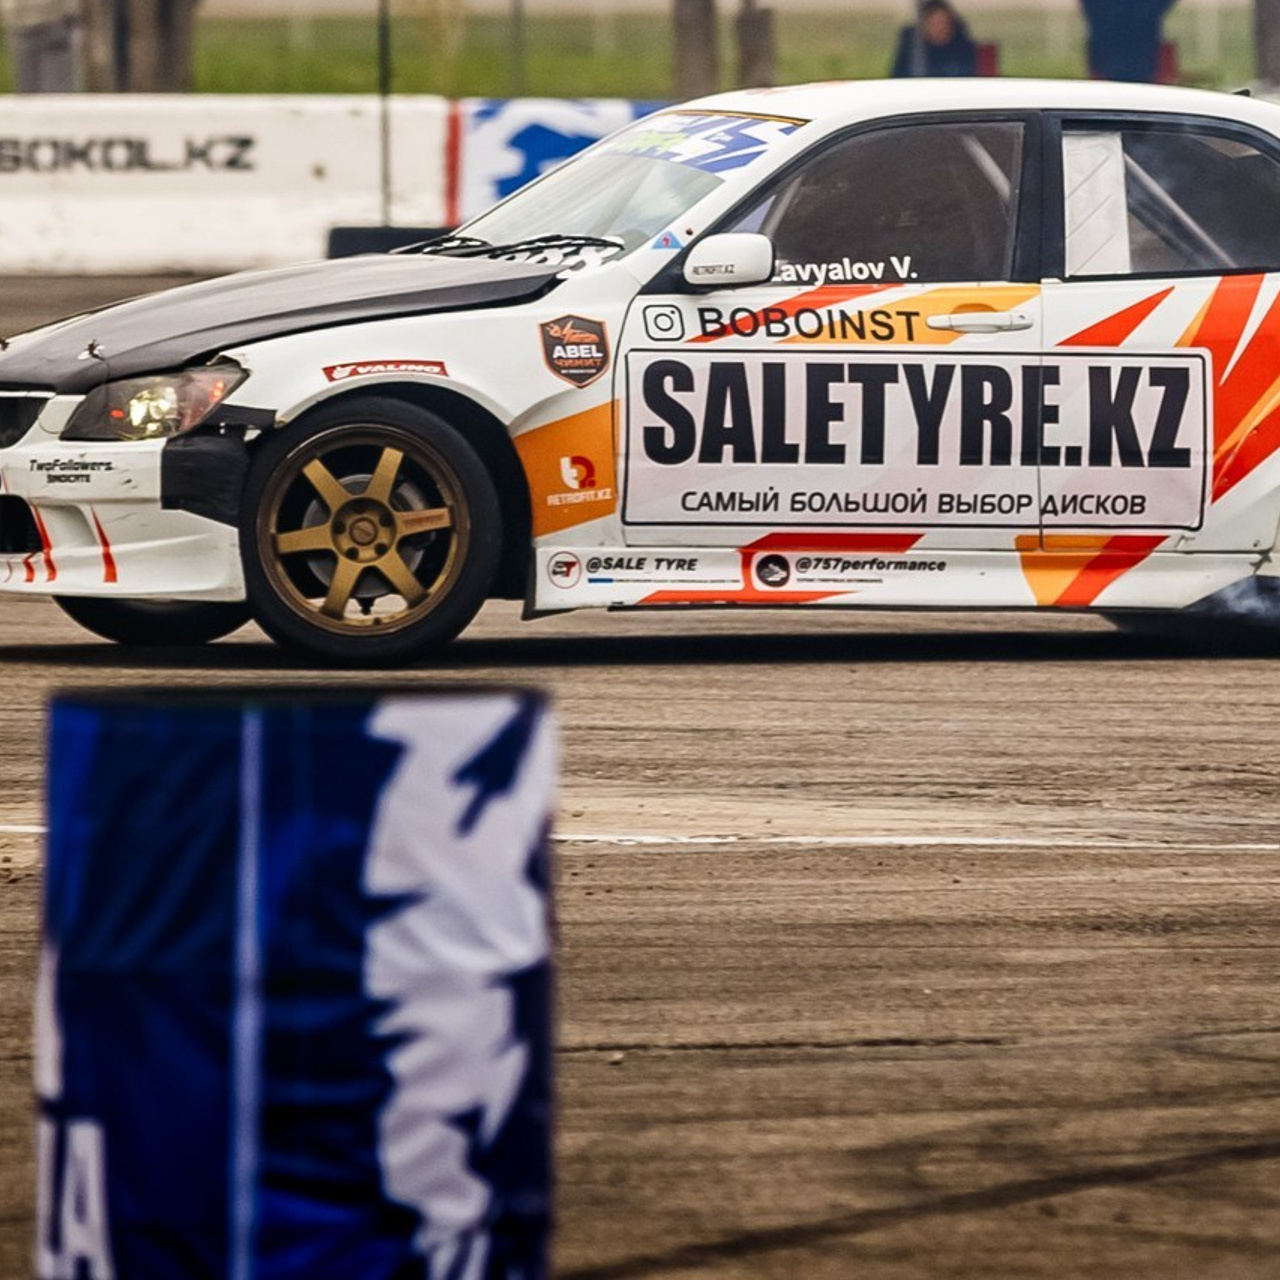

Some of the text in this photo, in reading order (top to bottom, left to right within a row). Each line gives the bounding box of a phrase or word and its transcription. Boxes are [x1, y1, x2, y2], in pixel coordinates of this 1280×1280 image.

[889, 256, 919, 279] V.
[697, 306, 921, 342] BOBOINST
[552, 344, 604, 358] ABEL
[356, 363, 442, 376] VALINO
[641, 359, 1193, 469] SALETYRE.KZ
[29, 459, 114, 472] TwoFollowers
[681, 486, 1147, 517] САМЫЙ БОЛЬШОЙ ВЫБОР ДИСКОВ
[795, 557, 947, 573] @757performance
